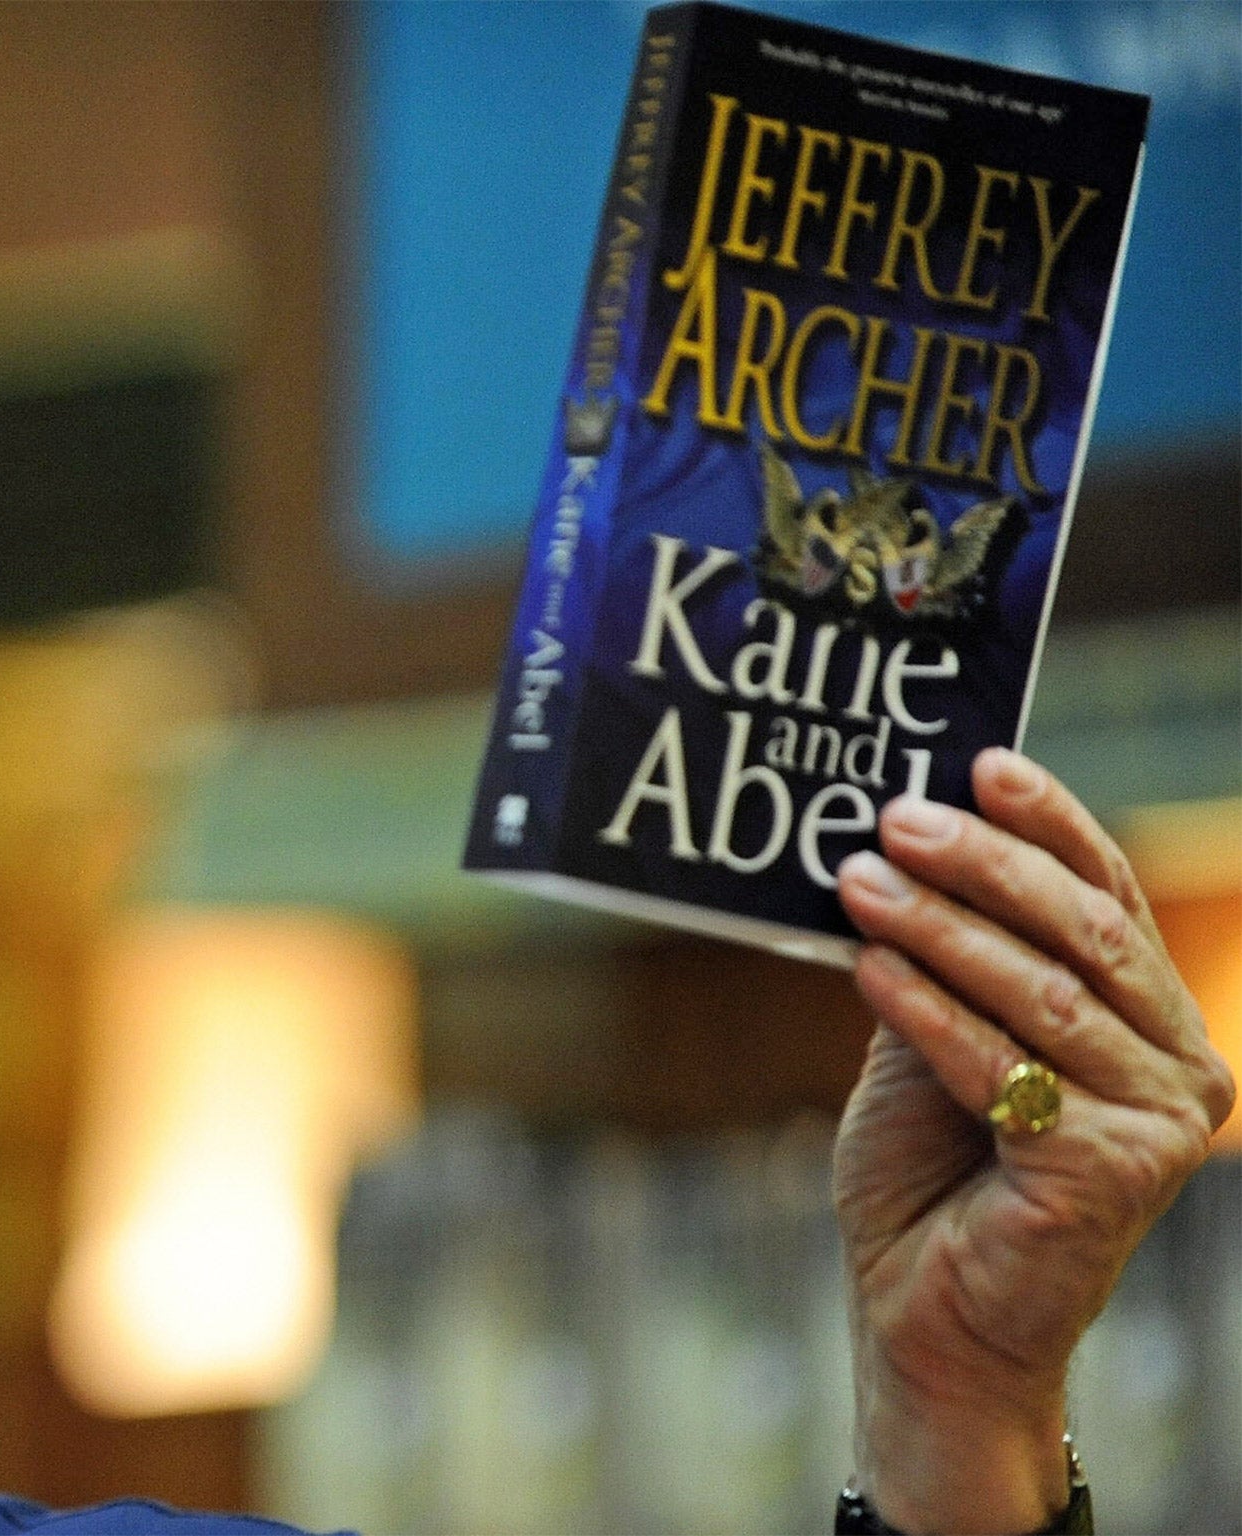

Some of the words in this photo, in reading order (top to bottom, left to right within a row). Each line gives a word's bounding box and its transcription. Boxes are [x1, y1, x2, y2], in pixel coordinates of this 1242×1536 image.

[663, 93, 1101, 323] JEFFREY
[641, 246, 1045, 494] ARCHER
[508, 629, 566, 751] Abel
[626, 532, 960, 735] Kane
[763, 714, 892, 789] and
